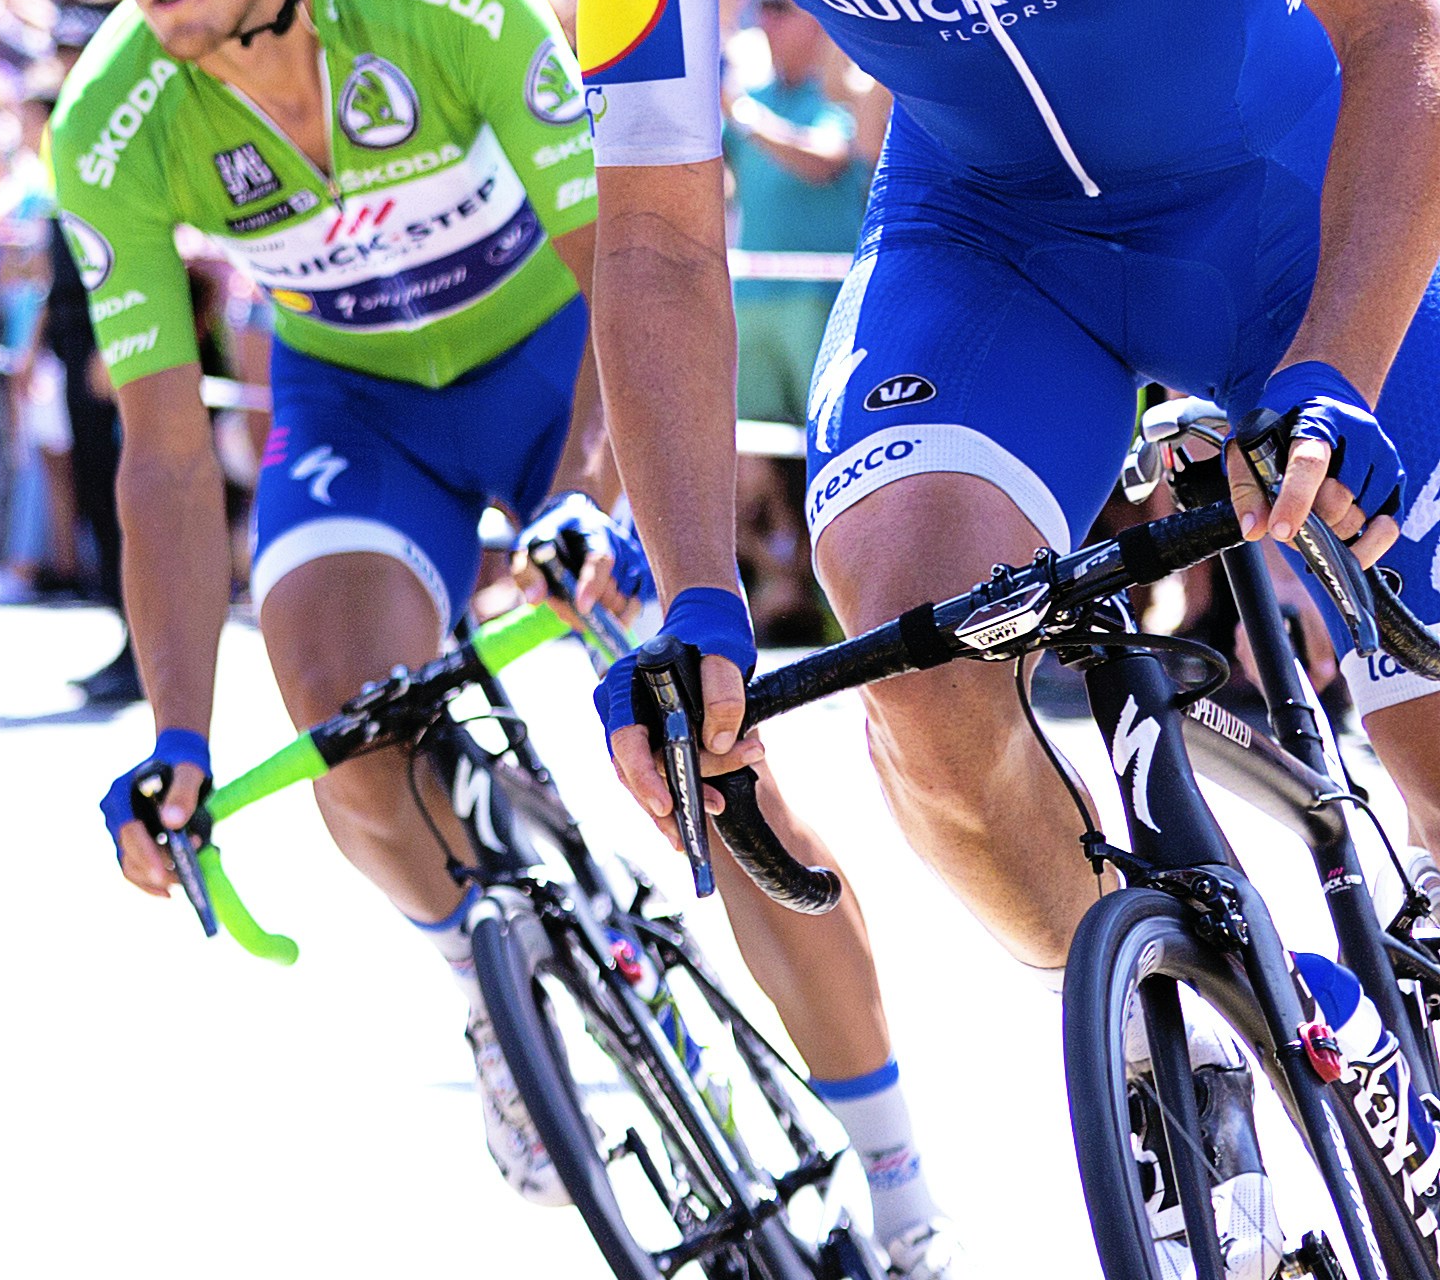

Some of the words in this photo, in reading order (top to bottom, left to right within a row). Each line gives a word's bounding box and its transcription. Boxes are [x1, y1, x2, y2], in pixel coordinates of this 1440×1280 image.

[77, 59, 177, 188] ŠKODA
[808, 440, 924, 529] texco
[1191, 699, 1252, 749] SPECIALIZED
